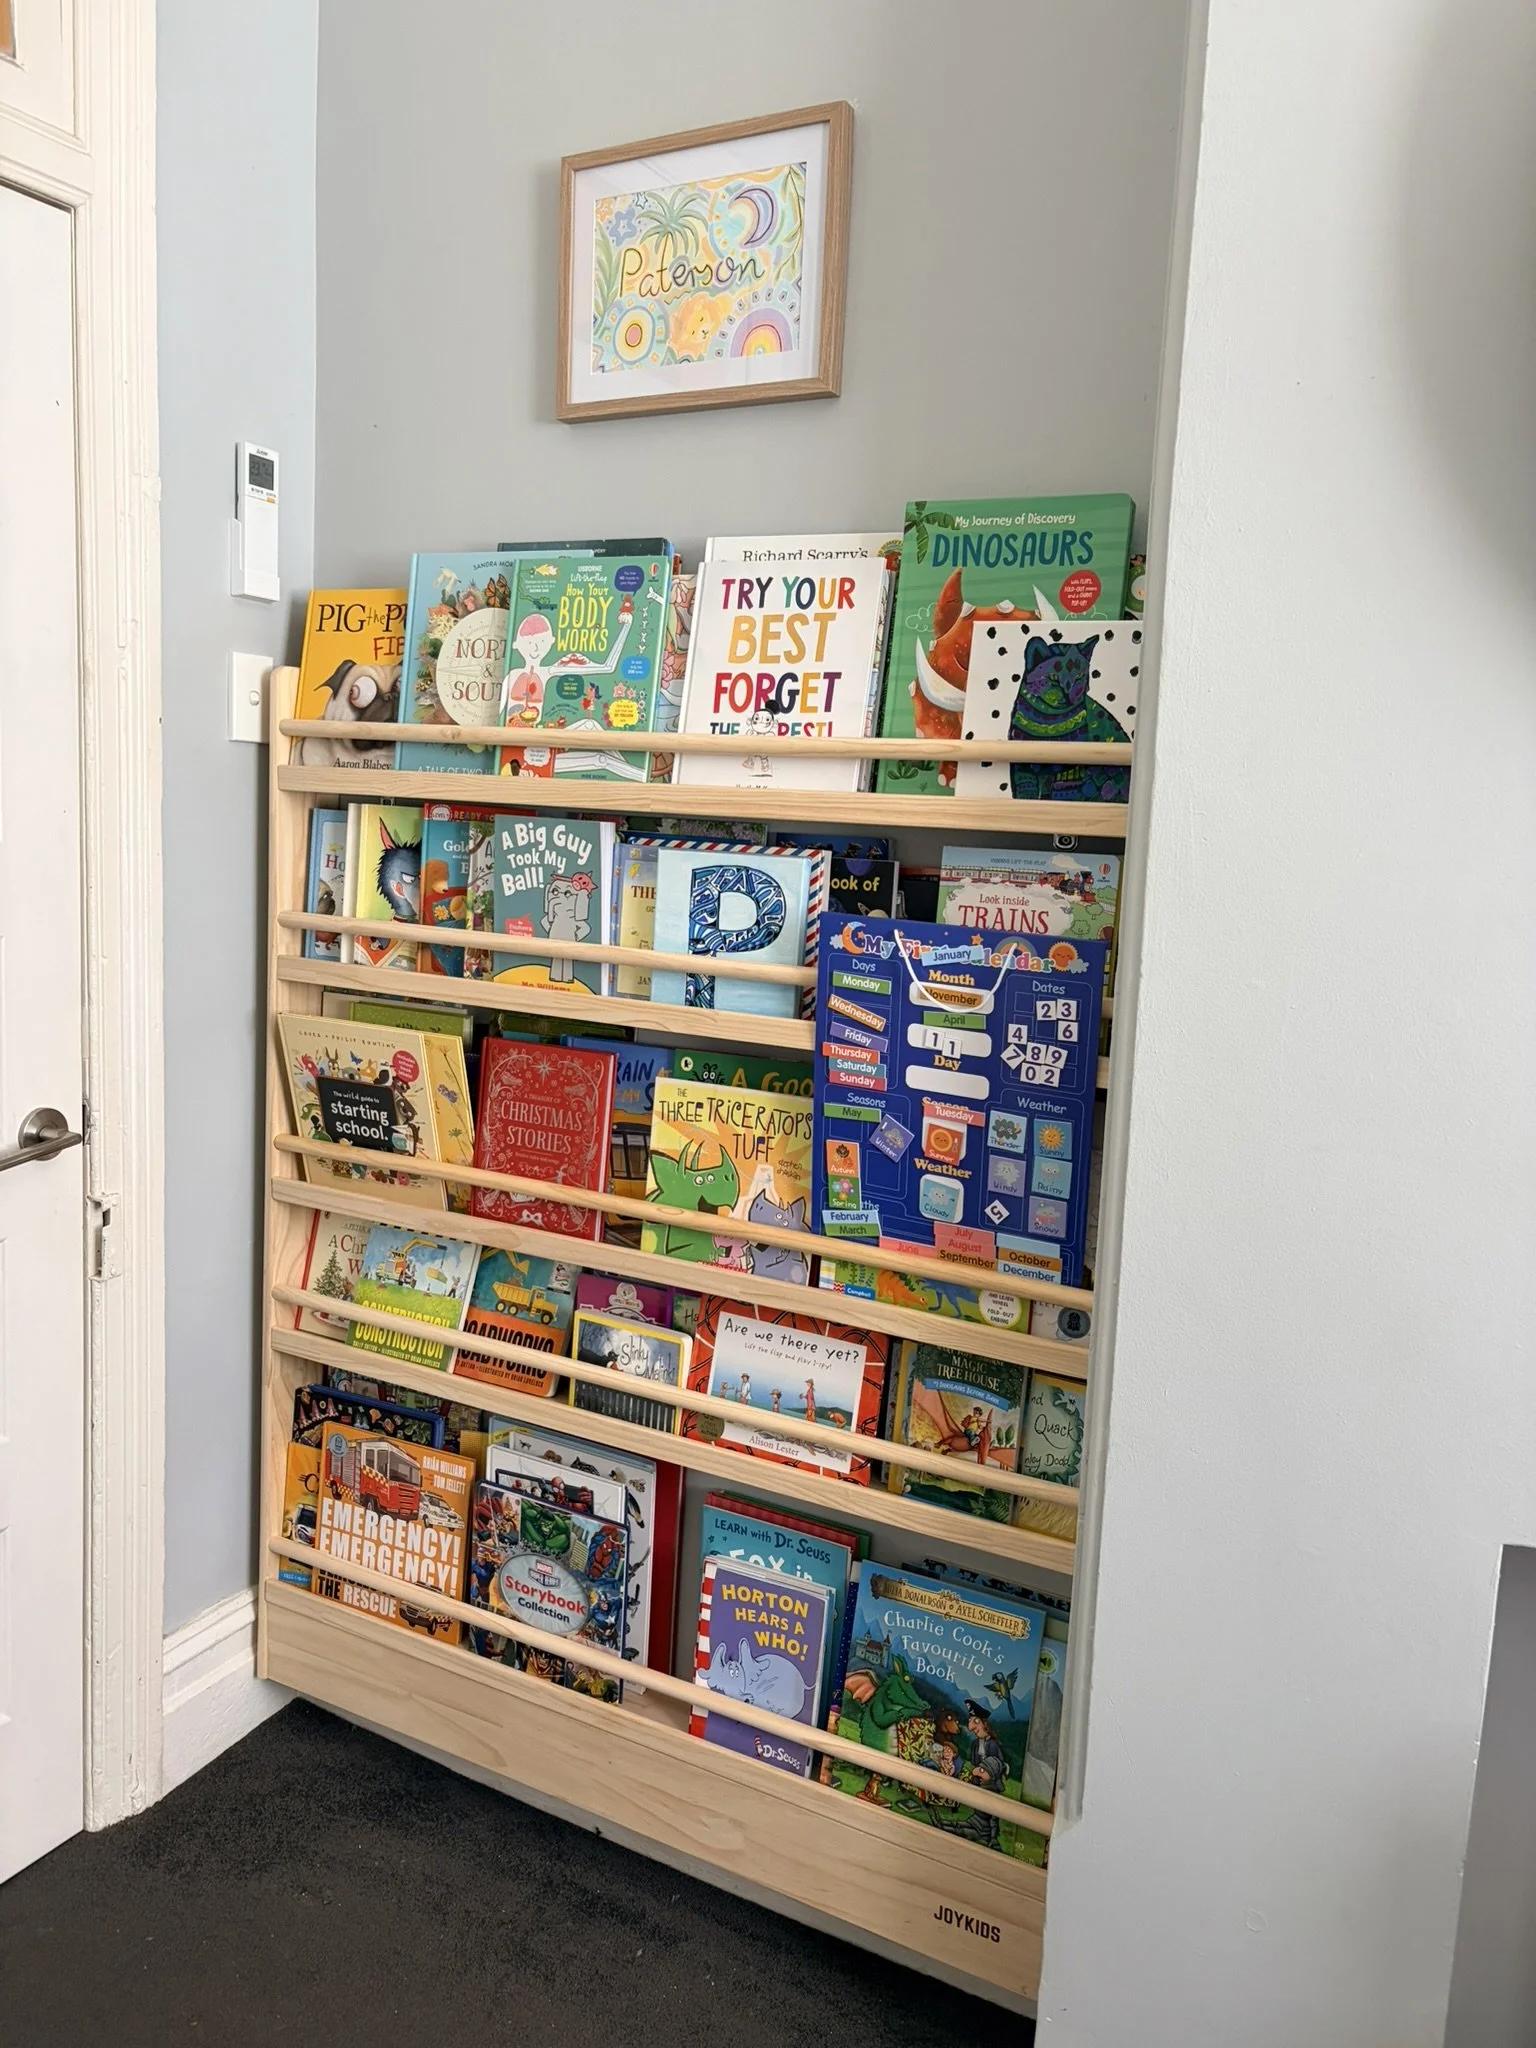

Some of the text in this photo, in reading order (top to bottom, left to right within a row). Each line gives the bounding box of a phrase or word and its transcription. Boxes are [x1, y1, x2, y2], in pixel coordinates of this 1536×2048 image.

[620, 248, 765, 297] Paterson
[955, 513, 1076, 527] My Journey of Discovery
[743, 550, 802, 562] Richard
[807, 547, 868, 561] Scarry's
[932, 530, 1094, 568] DINOSAURS
[722, 576, 856, 610] TRY YOUR
[316, 603, 385, 633] PIG the
[558, 595, 614, 629] BODY
[557, 629, 609, 652] WORKS
[727, 612, 837, 665] BEST
[483, 664, 493, 679] &
[712, 671, 842, 714] FORGET
[334, 757, 360, 769] Aaron
[453, 810, 482, 820] READY
[501, 830, 514, 851] A
[514, 822, 547, 851] Big
[552, 824, 592, 865] Guy
[507, 848, 541, 869] Took
[544, 849, 566, 874] My
[501, 867, 545, 896] Ball!
[863, 877, 880, 891] of
[979, 894, 1029, 907] Look inside
[958, 905, 1049, 935] TRAINS
[864, 934, 896, 959] My
[933, 949, 971, 961] January
[852, 959, 876, 973] Days
[843, 975, 880, 993] Monday
[928, 969, 975, 986] Month
[1032, 980, 1066, 995] Dates
[830, 996, 884, 1029] Wednesday
[943, 1012, 966, 1026] April
[1041, 1002, 1072, 1018] 2 3
[844, 1028, 872, 1047] Friday
[1012, 1024, 1073, 1042] 4 6
[830, 1044, 872, 1061] Thursday
[932, 1033, 955, 1056] 1 1
[934, 1055, 962, 1071] Day
[1006, 1046, 1063, 1064] 7 8 9
[836, 1059, 877, 1077] Saturday
[1025, 1066, 1055, 1084] 0 2
[732, 1068, 748, 1088] A
[840, 1072, 875, 1087] Sunday
[343, 1091, 359, 1100] wild
[677, 1088, 688, 1098] THE
[847, 1092, 886, 1108] Seasons
[331, 1101, 389, 1127] starting
[659, 1099, 703, 1123] THREE
[842, 1107, 862, 1118] May
[935, 1106, 974, 1123] Tuesday
[1017, 1096, 1067, 1114] Weather
[500, 1100, 583, 1132] CHRISTMAS
[336, 1119, 389, 1141] school.
[506, 1125, 572, 1154] STORIES
[733, 1133, 775, 1162] TUFF
[876, 1137, 898, 1158] Winter
[990, 1138, 1021, 1150] Thunder
[831, 1164, 855, 1175] Autumn
[913, 1157, 972, 1179] Weather
[993, 1182, 1017, 1193] Windy
[1038, 1181, 1063, 1196] Rainy
[831, 1211, 869, 1223] February
[924, 1203, 949, 1218] Cloudy
[990, 1205, 1003, 1220] 5
[839, 1225, 867, 1236] March
[954, 1228, 973, 1240] July
[1034, 1222, 1060, 1235] Snowy
[328, 1234, 339, 1249] A
[897, 1243, 919, 1255] June
[948, 1239, 982, 1253] August
[939, 1250, 995, 1269] September
[1008, 1251, 1052, 1268] October
[1003, 1262, 1055, 1282] December
[847, 1287, 872, 1298] Campbell
[724, 1317, 860, 1364] Are we there yet?
[952, 1355, 988, 1374] MAGIC
[937, 1363, 1000, 1392] TREE HOUSE
[1034, 1413, 1075, 1449] Quack
[749, 1435, 800, 1456] Alison Lester
[440, 1460, 467, 1480] WILLIAMS
[433, 1474, 446, 1489] TOM
[321, 1497, 460, 1562] EMERGENCY!
[715, 1518, 831, 1564] LEARN with Dr. Seuss
[319, 1527, 458, 1597] EMERGENCY!
[317, 1575, 341, 1600] THE
[343, 1583, 397, 1619] RESCUE
[504, 1575, 587, 1615] Storybook
[721, 1584, 809, 1619] HORTON
[518, 1597, 570, 1623] Collection
[904, 1588, 947, 1611] DONALDSON
[956, 1604, 976, 1620] AXEL
[976, 1611, 1020, 1632] SCHEFFLER
[735, 1607, 805, 1636] HEARS A
[754, 1630, 809, 1662] WHO!
[884, 1610, 1005, 1665] Charlie Cook's
[902, 1635, 985, 1677] Favourite
[916, 1657, 956, 1682] Book
[934, 1905, 1001, 1943] JOYKIDS
